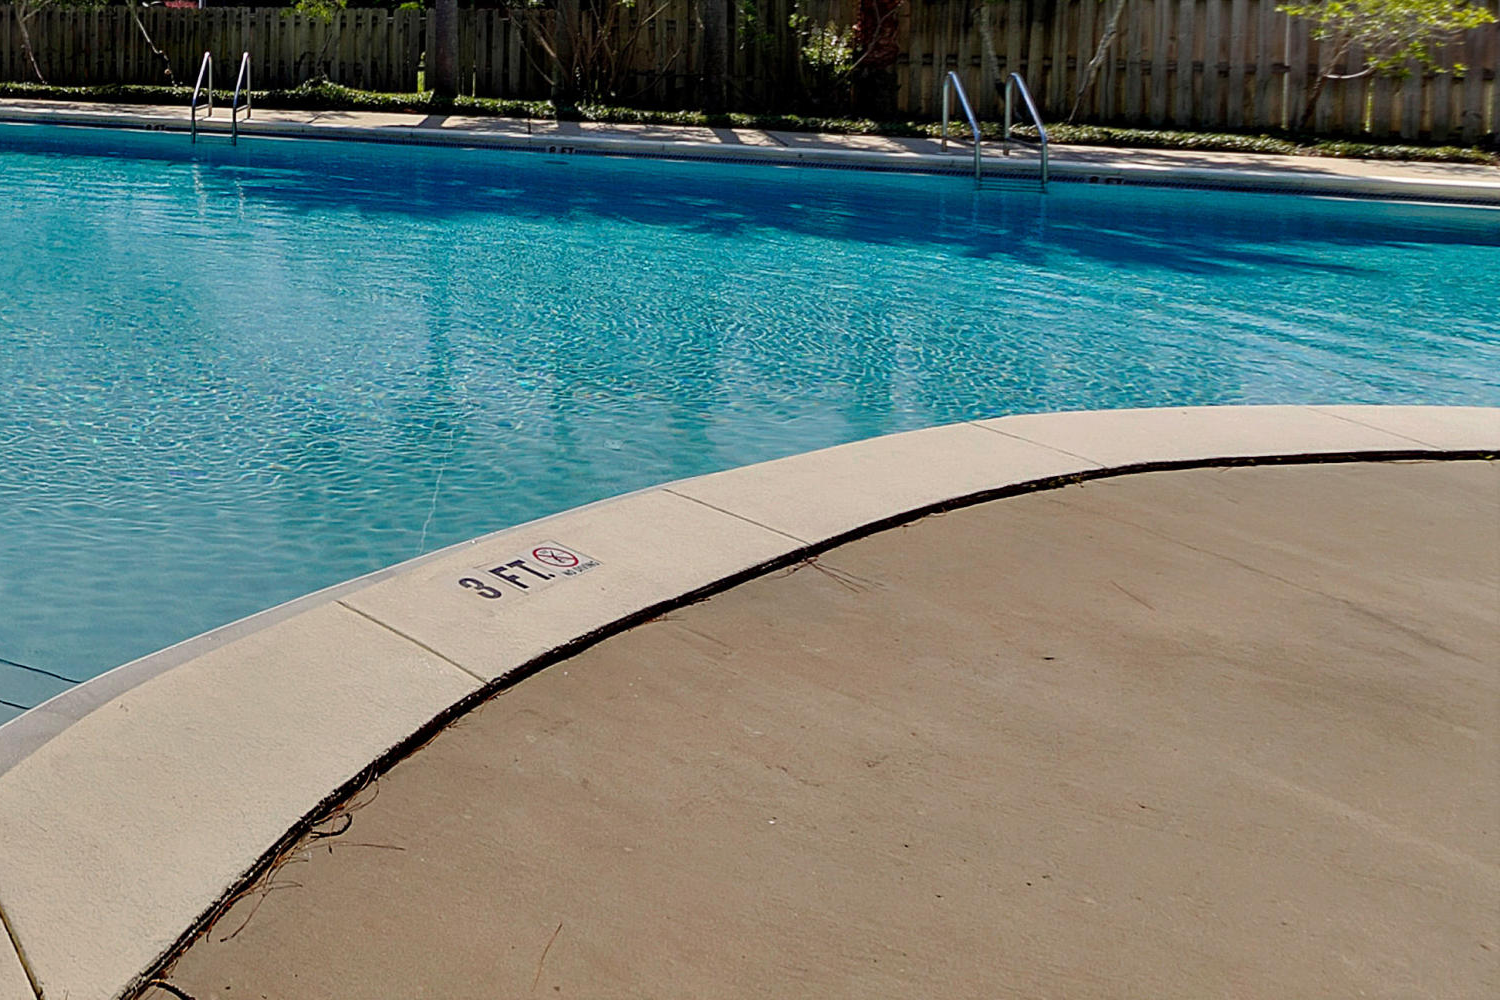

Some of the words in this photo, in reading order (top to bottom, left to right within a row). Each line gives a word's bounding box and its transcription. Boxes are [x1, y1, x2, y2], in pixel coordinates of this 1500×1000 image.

[458, 577, 502, 600] 3
[488, 559, 556, 590] FT.
[562, 567, 577, 577] NO
